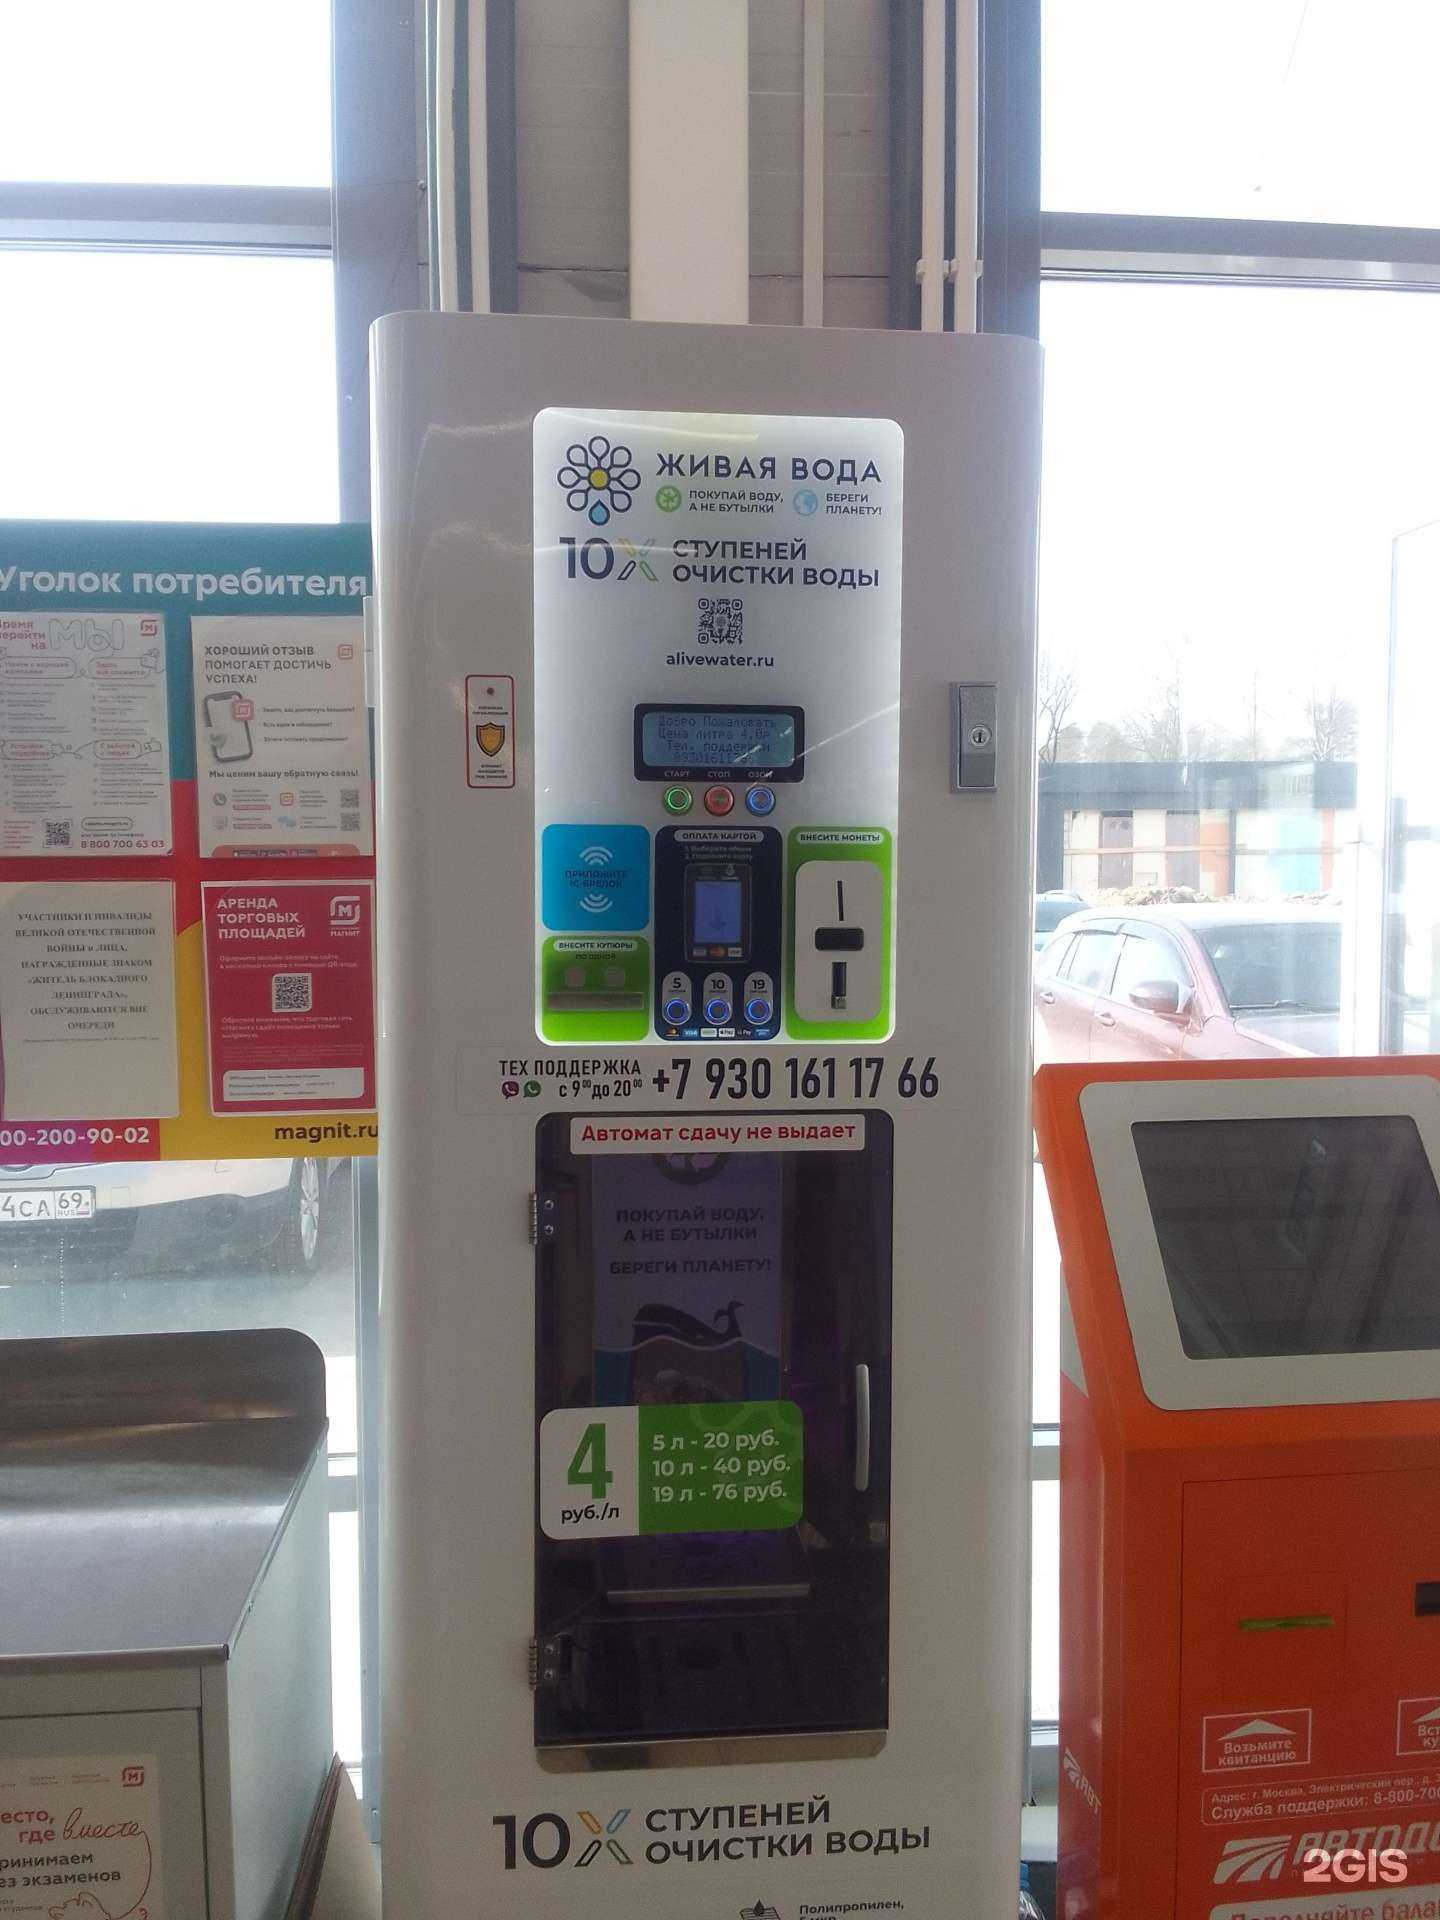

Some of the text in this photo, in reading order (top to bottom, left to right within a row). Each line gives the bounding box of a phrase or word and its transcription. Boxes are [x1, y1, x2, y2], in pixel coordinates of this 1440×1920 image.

[655, 453, 882, 485] ЖИВАЯ ВОДА
[689, 488, 784, 503] ПОКУПАЙ ВОДУ,
[826, 493, 869, 502] БЕРЕГИ
[689, 503, 774, 514] А НЕ БУТЫЛКИ
[826, 505, 882, 516] ПЛАНЕТУ!
[672, 538, 807, 561] СТУПЕНЕЙ
[672, 564, 879, 589] ОЧИСТКИ ВОДЫ
[0, 566, 367, 601] Уголок потребителя
[0, 619, 33, 631] ремя
[0, 630, 46, 641] ерейти
[31, 642, 48, 650] на
[205, 644, 314, 656] ХОРОШИЙ ОТЗЫВ
[205, 660, 332, 672] ПОМОГАЕТ ДОСТИЧЬ
[666, 652, 774, 667] alivewater.ru
[206, 674, 257, 684] УСПЕХА!
[658, 716, 697, 728] Добро
[658, 729, 689, 740] Цена
[703, 742, 771, 753] поддери
[682, 831, 757, 840] ОПЛАТА КАРТОЙ
[842, 834, 880, 842] МОНЕТЫ
[81, 840, 164, 849] 8 800 700 63 03
[217, 898, 278, 909] АРЕНДА
[17, 913, 82, 922] УЧАСТНИКИ
[95, 912, 153, 922] ИНВАЛИДЫ
[217, 912, 299, 924] ТОРГОВЫХ
[16, 927, 156, 937] ВЕЛИКОЙ ОТЕЧЕСТВЕННОЙ
[218, 925, 305, 939] ПЛОЩАДЕЙ
[47, 944, 85, 953] ВОЙНЫ
[21, 959, 153, 969] НАГРАЖДЕННЫЕ ЗНАКОМ
[79, 975, 148, 984] БЛОКАДНОГО
[673, 977, 682, 989] 5
[711, 979, 725, 989] 10
[752, 979, 766, 990] 19
[30, 1006, 147, 1016] ОБСЛУЖИВАЮТСЯ ВНЕ
[68, 1022, 115, 1030] ОЧЕРЕДИ
[499, 1059, 641, 1078] ТЕХ ПОДДЕРЖКА
[652, 1056, 939, 1099] +7 930 161 17 66
[559, 1086, 567, 1098] с
[274, 1122, 378, 1143] magnit.ru
[581, 1124, 856, 1144] Автомат сдачу не выдает
[58, 1192, 83, 1209] 69
[616, 1205, 764, 1223] ПОКУПАЙ ВОДУ,
[623, 1226, 758, 1242] А НЕ БУТЫЛКИ
[609, 1258, 772, 1275] БЕРЕГИ ПЛАНЕТУ!
[653, 1429, 780, 1451] 5 л 20 руб.
[567, 1423, 614, 1500] 4
[653, 1455, 791, 1476] 10 л 40 руб.
[653, 1480, 788, 1503] 19 л 76 руб.
[561, 1502, 620, 1524] руб./л
[1223, 1740, 1293, 1754] Возьмите
[1218, 1751, 1297, 1767] квитанцию
[1211, 1793, 1250, 1804] Адрес:
[645, 1794, 830, 1834] СТУПЕНЕЙ
[1211, 1802, 1273, 1820] Служба
[1277, 1796, 1369, 1813] поддержки:
[19, 1830, 56, 1844] где
[645, 1826, 930, 1865] ОЧИСТКИ ВОДЫ
[22, 1871, 121, 1888] экзаменов
[799, 1900, 904, 1914] Полипропилен,
[1381, 1898, 1440, 1920] бала
